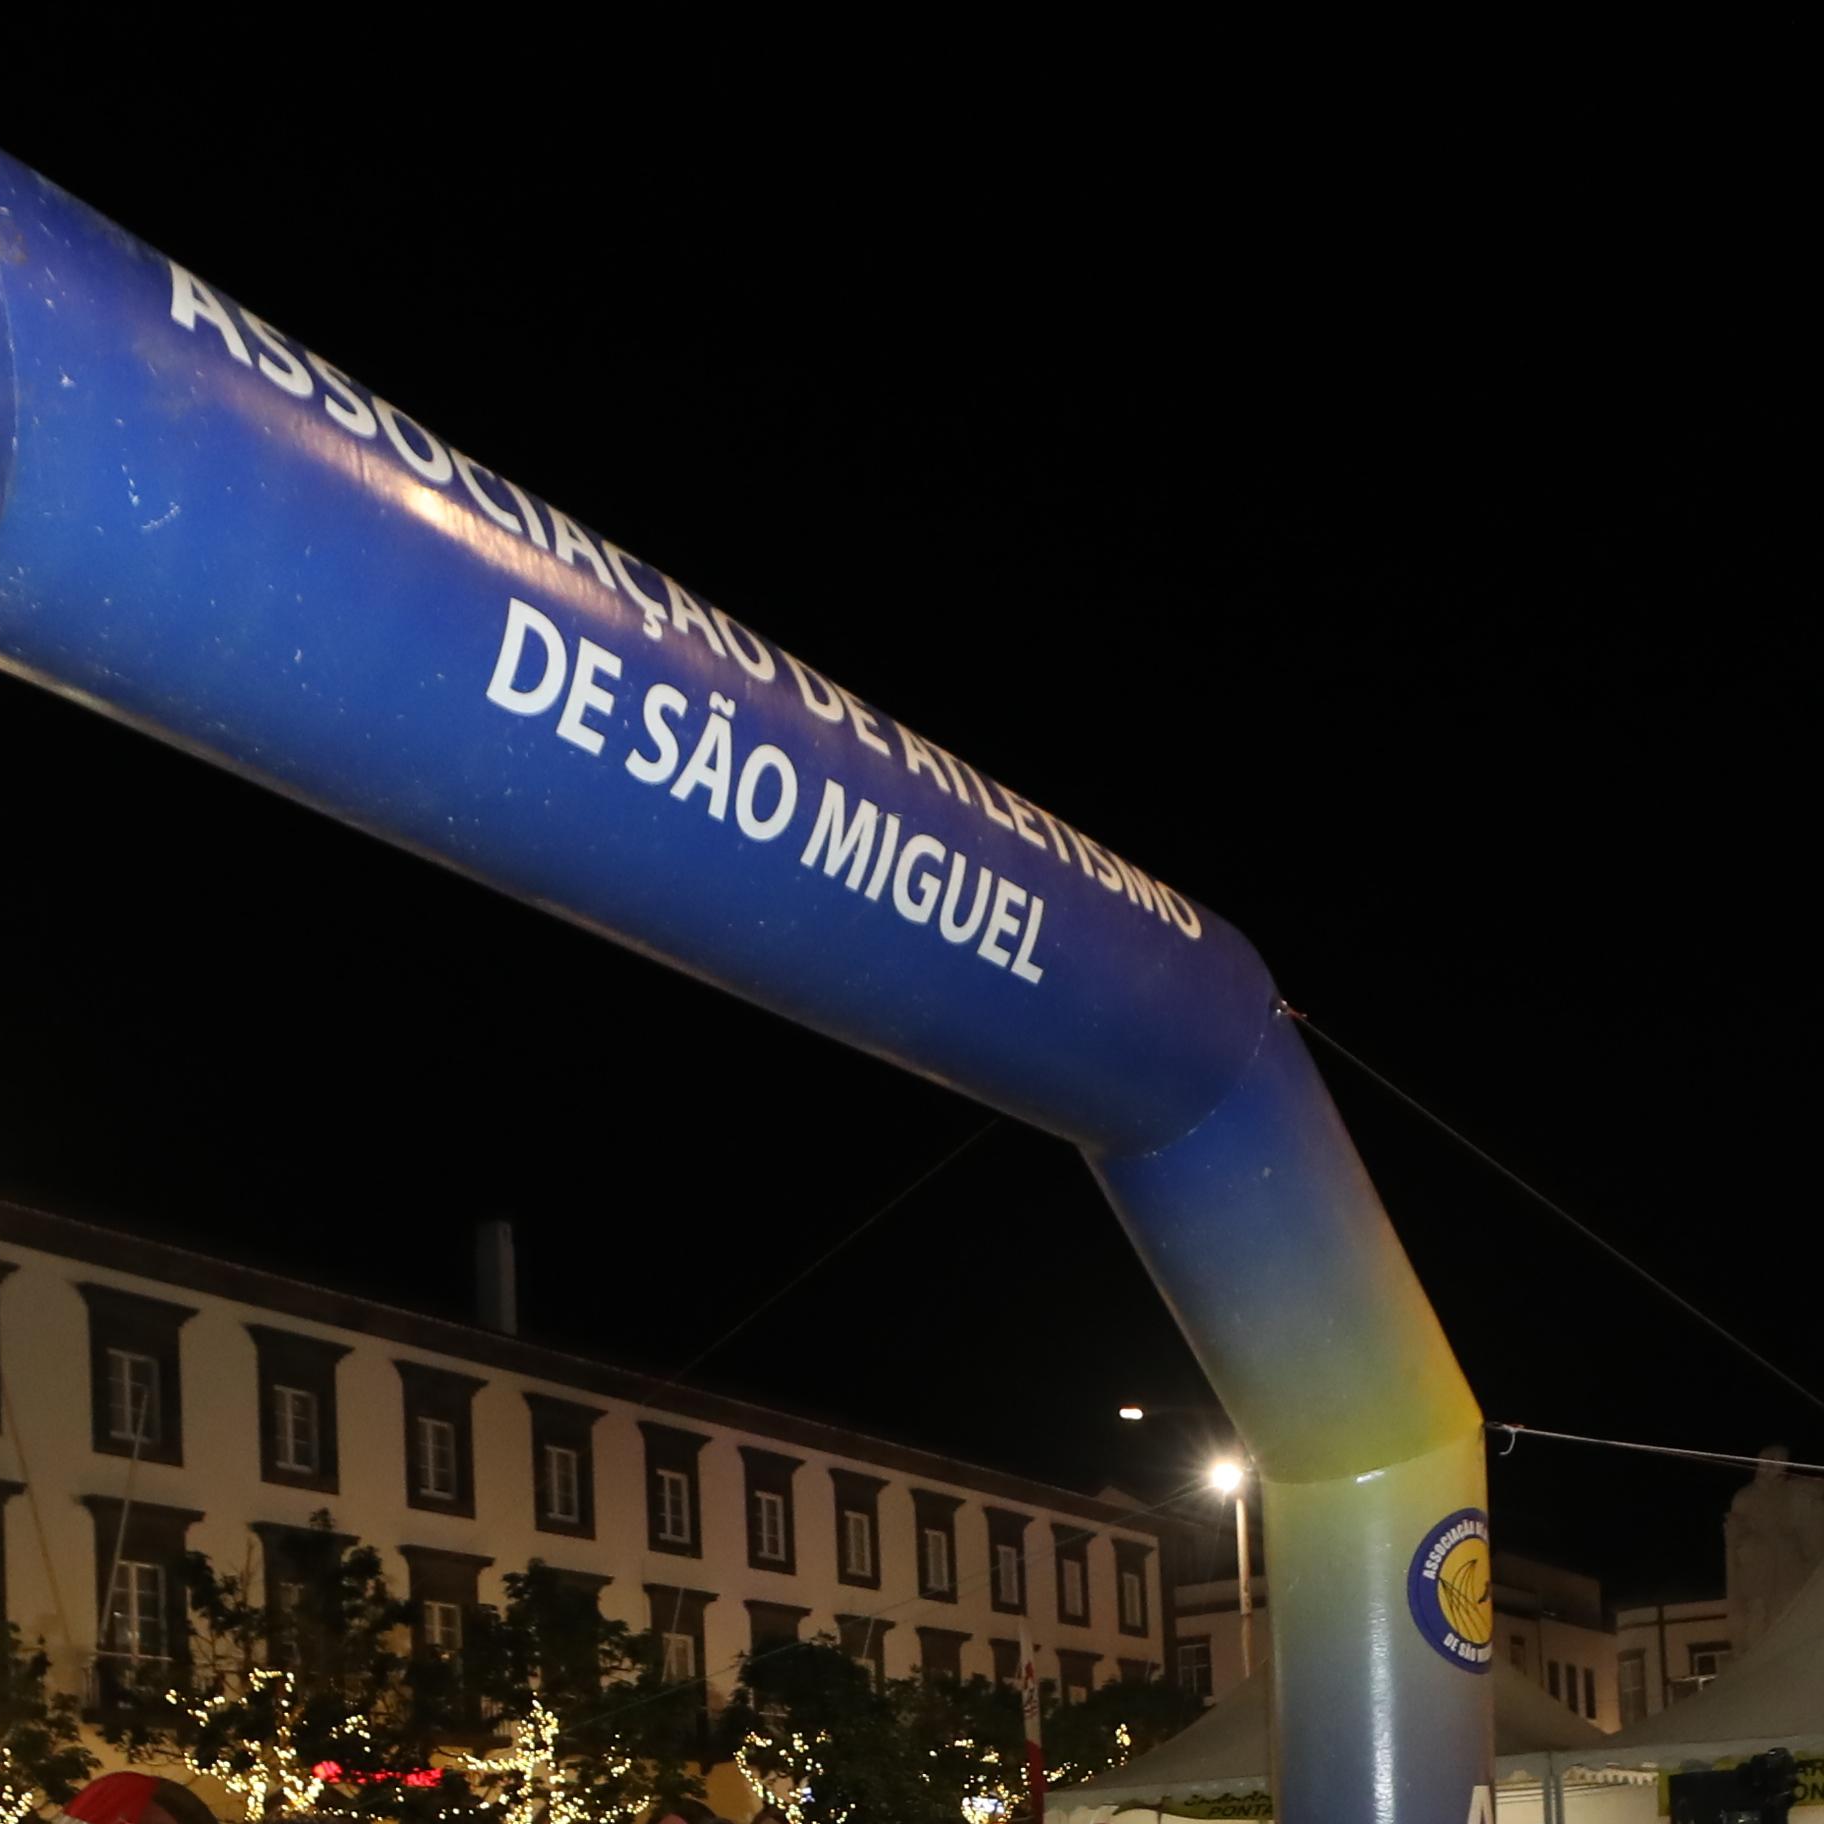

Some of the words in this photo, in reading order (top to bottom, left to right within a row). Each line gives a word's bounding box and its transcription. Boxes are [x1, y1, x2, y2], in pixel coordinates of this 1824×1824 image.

[484, 596, 624, 756] DE
[624, 682, 800, 844] SÃO
[799, 778, 1049, 986] MIGUEL
[794, 654, 892, 757] DE
[904, 722, 1204, 942] ATLETISMO
